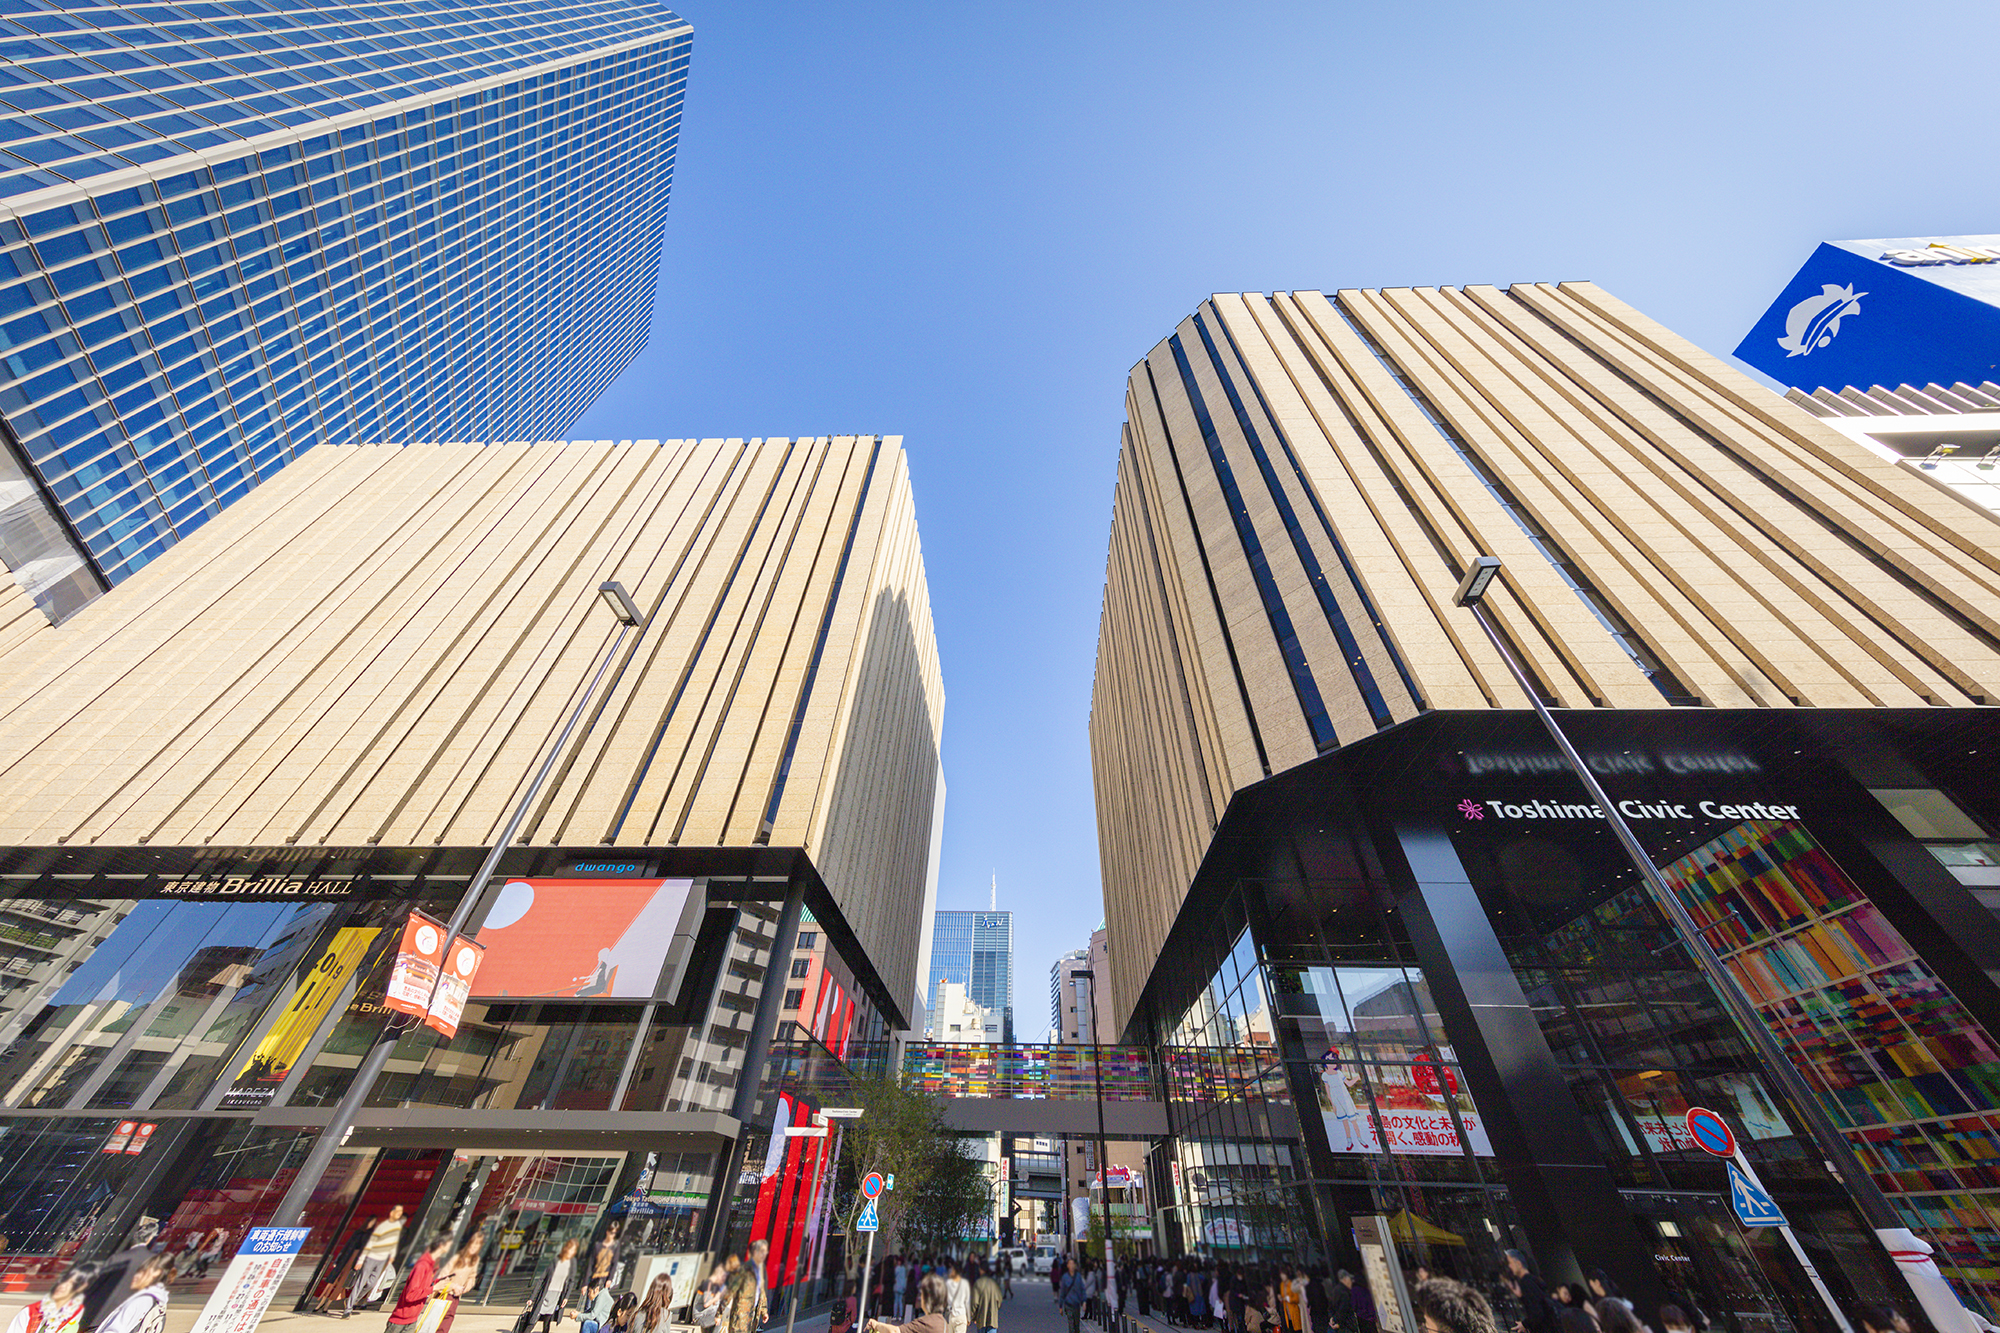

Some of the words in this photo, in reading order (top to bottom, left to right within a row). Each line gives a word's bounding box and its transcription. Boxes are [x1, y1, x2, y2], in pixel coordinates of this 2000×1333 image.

[1618, 800, 1694, 820] Civic
[1699, 801, 1802, 821] Center
[574, 862, 635, 874] dwango
[160, 881, 220, 894] 東京建物
[219, 878, 303, 894] Brillia
[303, 881, 353, 895] HALL
[314, 952, 343, 979] 019
[360, 1002, 393, 1015] Brill
[1366, 1114, 1476, 1131] 豊島の文化と未が
[253, 1241, 292, 1253] のお知らせ
